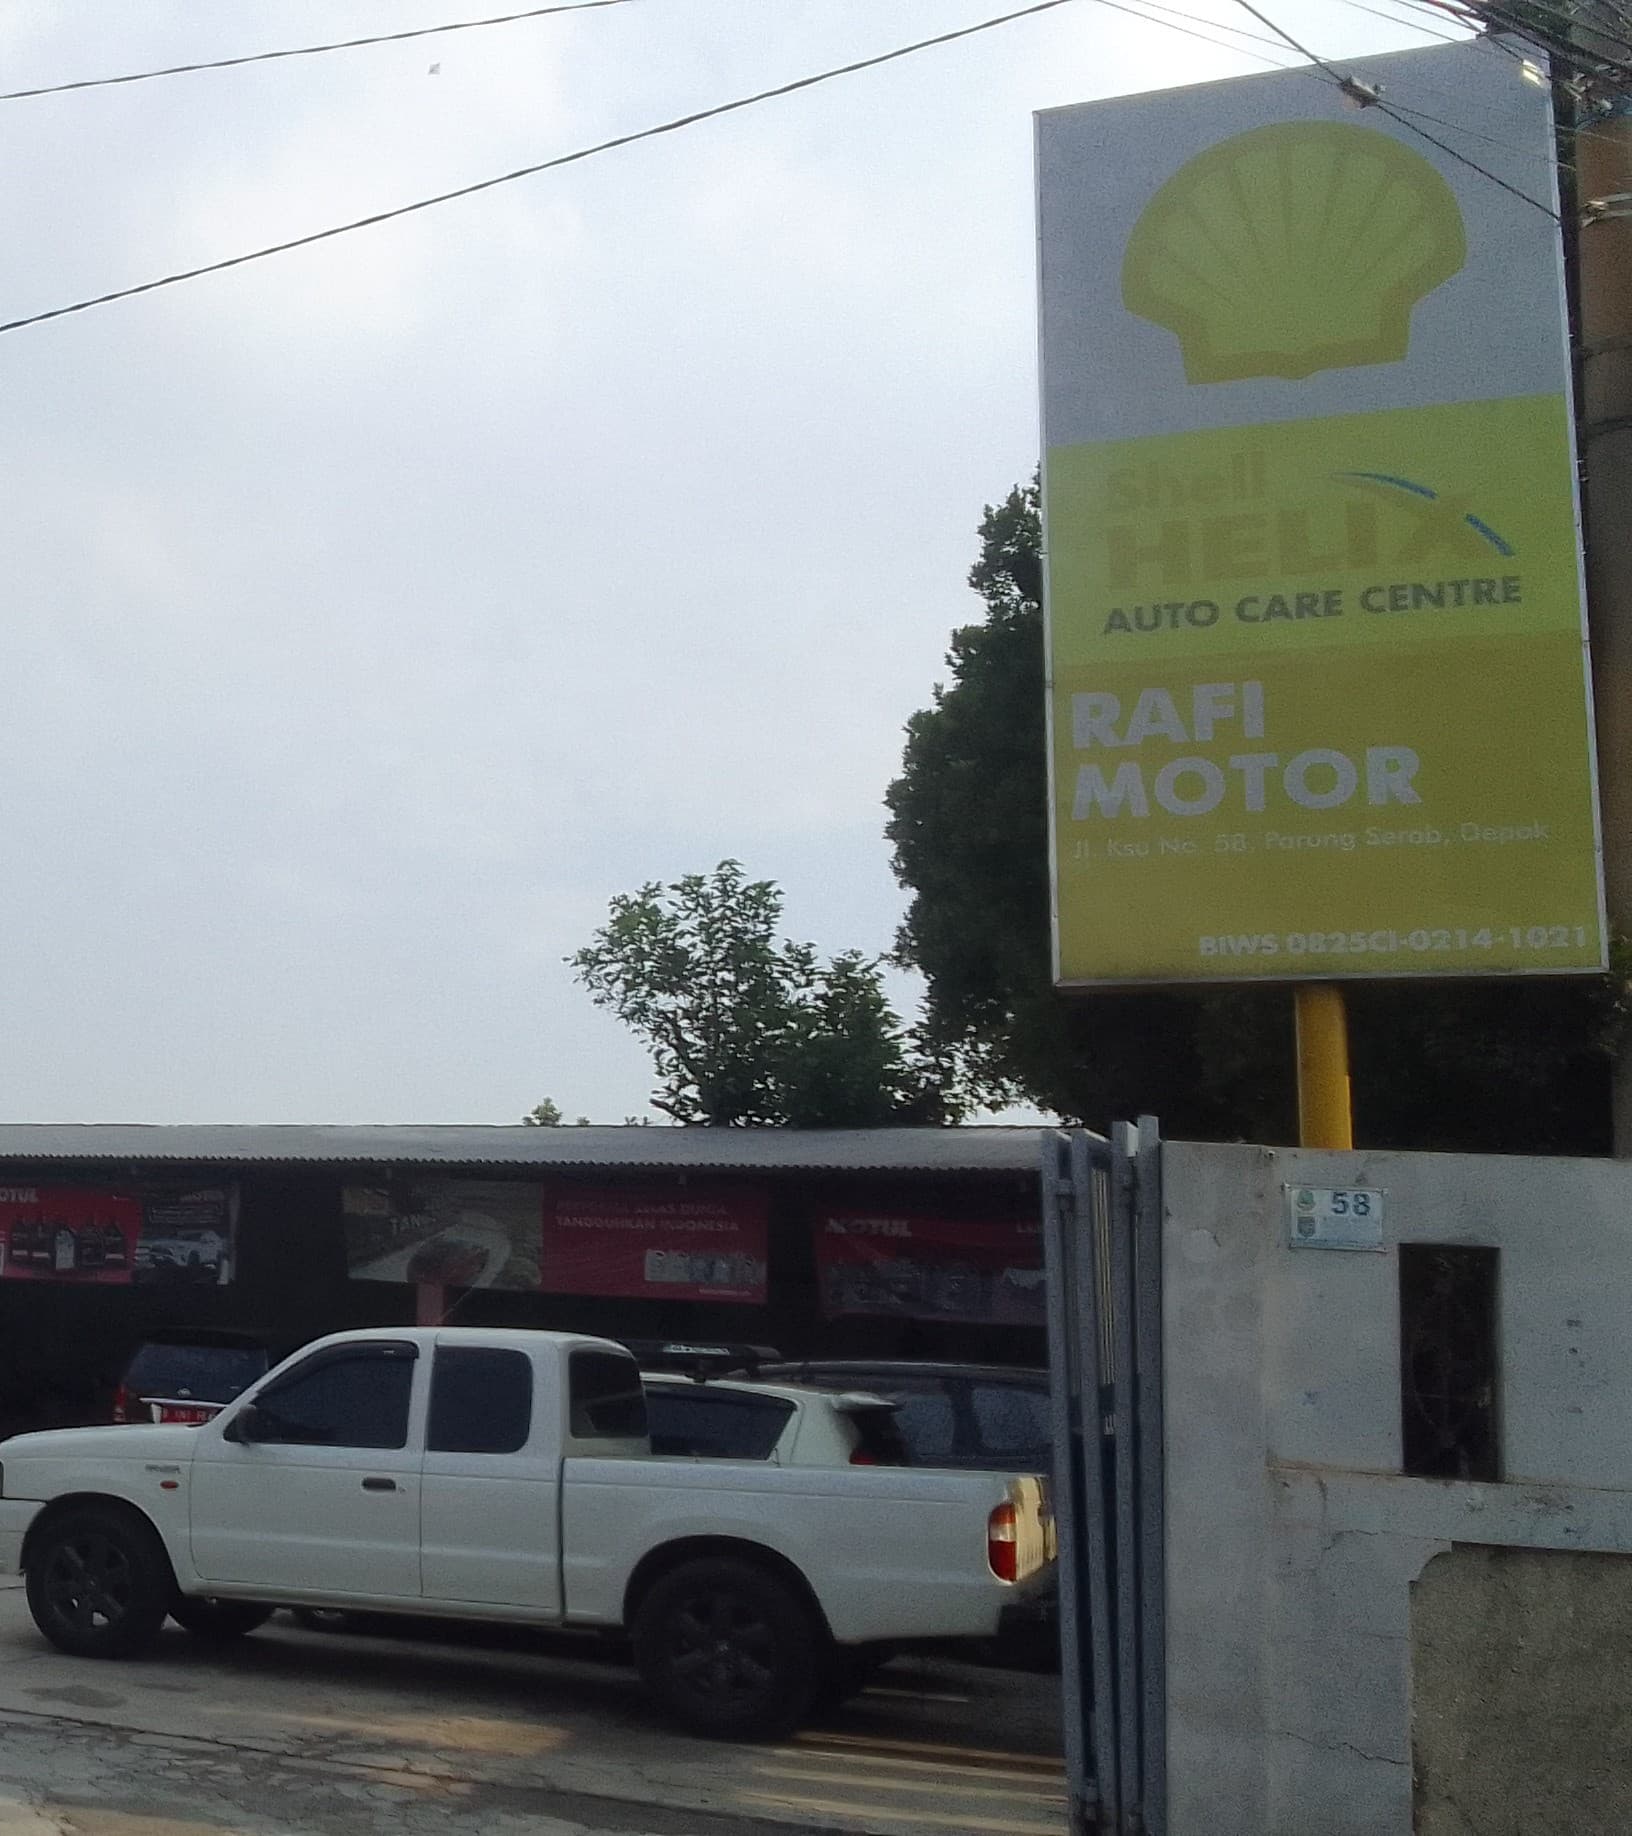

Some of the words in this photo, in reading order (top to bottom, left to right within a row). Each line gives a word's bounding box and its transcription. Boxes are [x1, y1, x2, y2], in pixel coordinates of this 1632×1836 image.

[1106, 450, 1266, 511] Shell
[1106, 474, 1496, 590] HELIX
[1103, 599, 1221, 635] AUTO
[1234, 589, 1344, 624] CARE
[1358, 575, 1524, 614] CENTRE
[1071, 681, 1266, 749] RAFI
[1071, 746, 1424, 821] MOTOR
[1263, 831, 1357, 852] Parung
[1198, 934, 1279, 957] BIWS
[1330, 1191, 1372, 1217] 58
